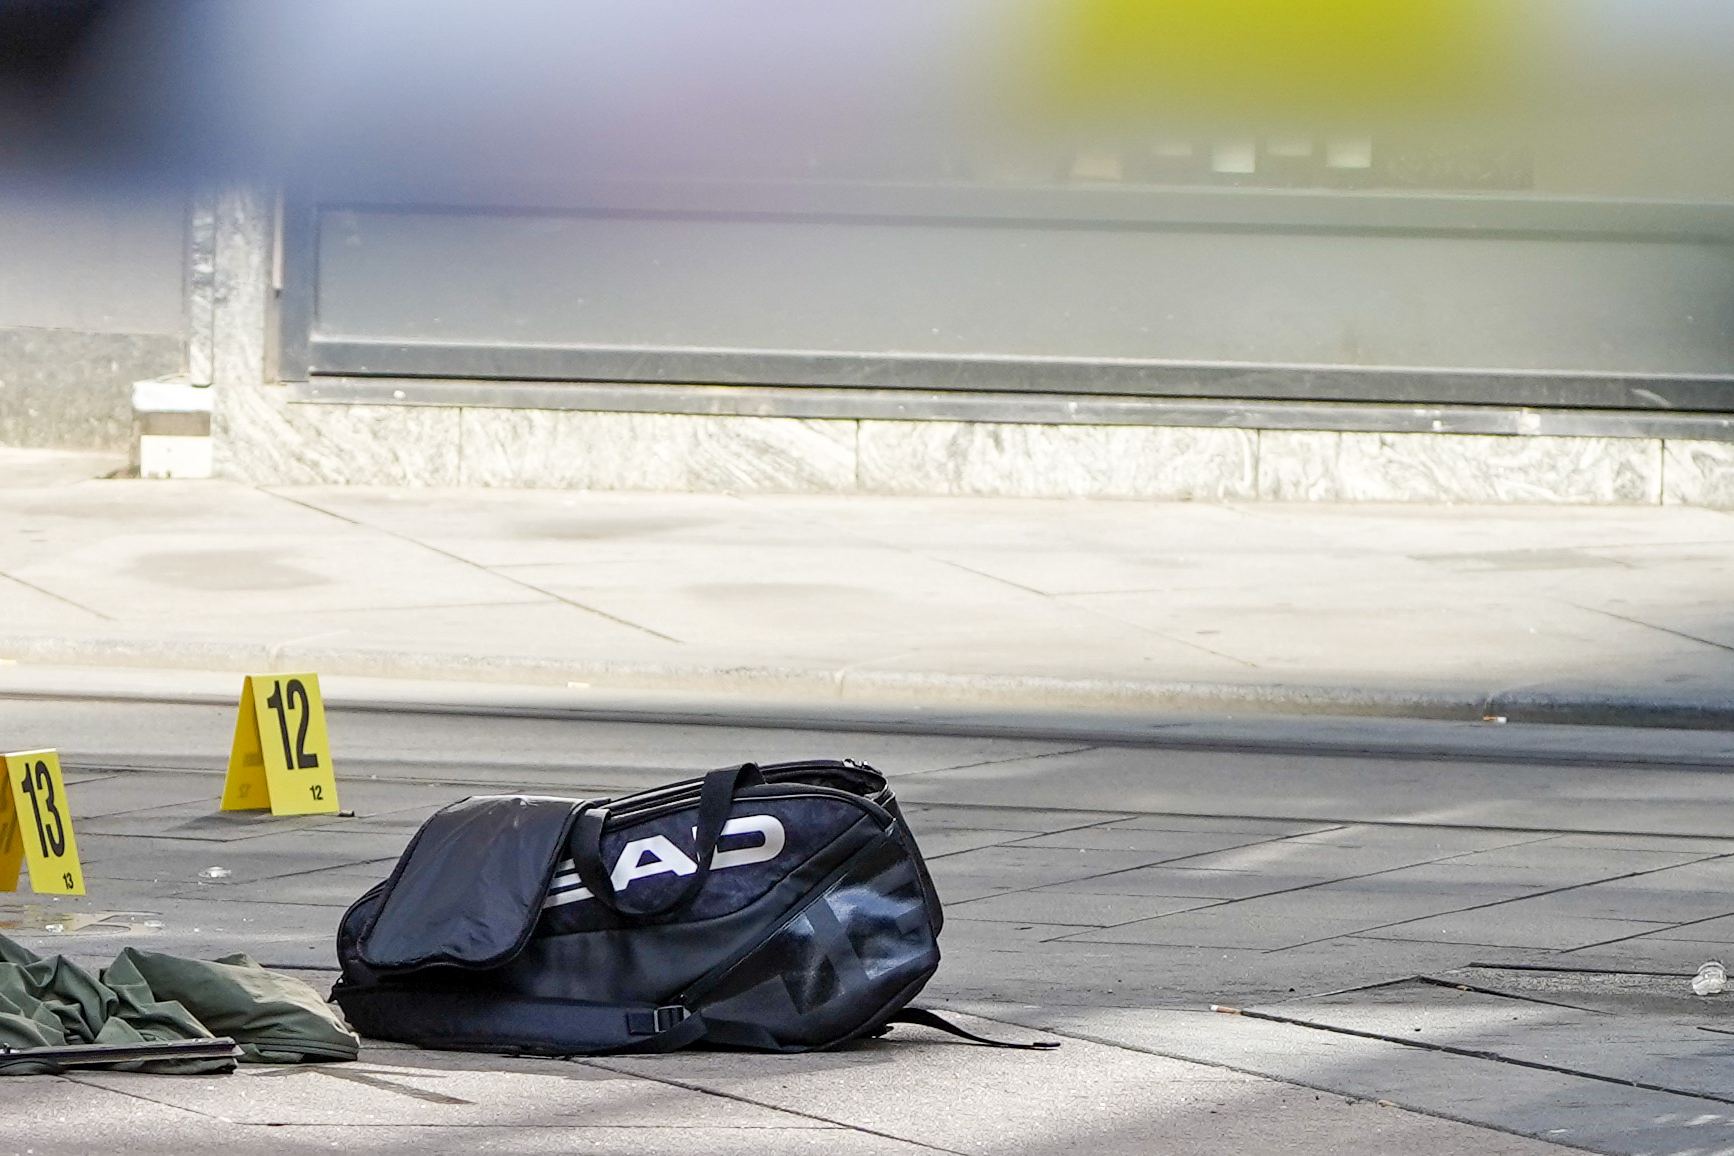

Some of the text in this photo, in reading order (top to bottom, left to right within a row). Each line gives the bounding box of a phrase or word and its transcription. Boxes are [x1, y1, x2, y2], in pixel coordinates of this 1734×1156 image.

[267, 679, 319, 770] 12
[21, 760, 65, 858] 13
[309, 785, 323, 800] 12
[63, 872, 73, 889] 13
